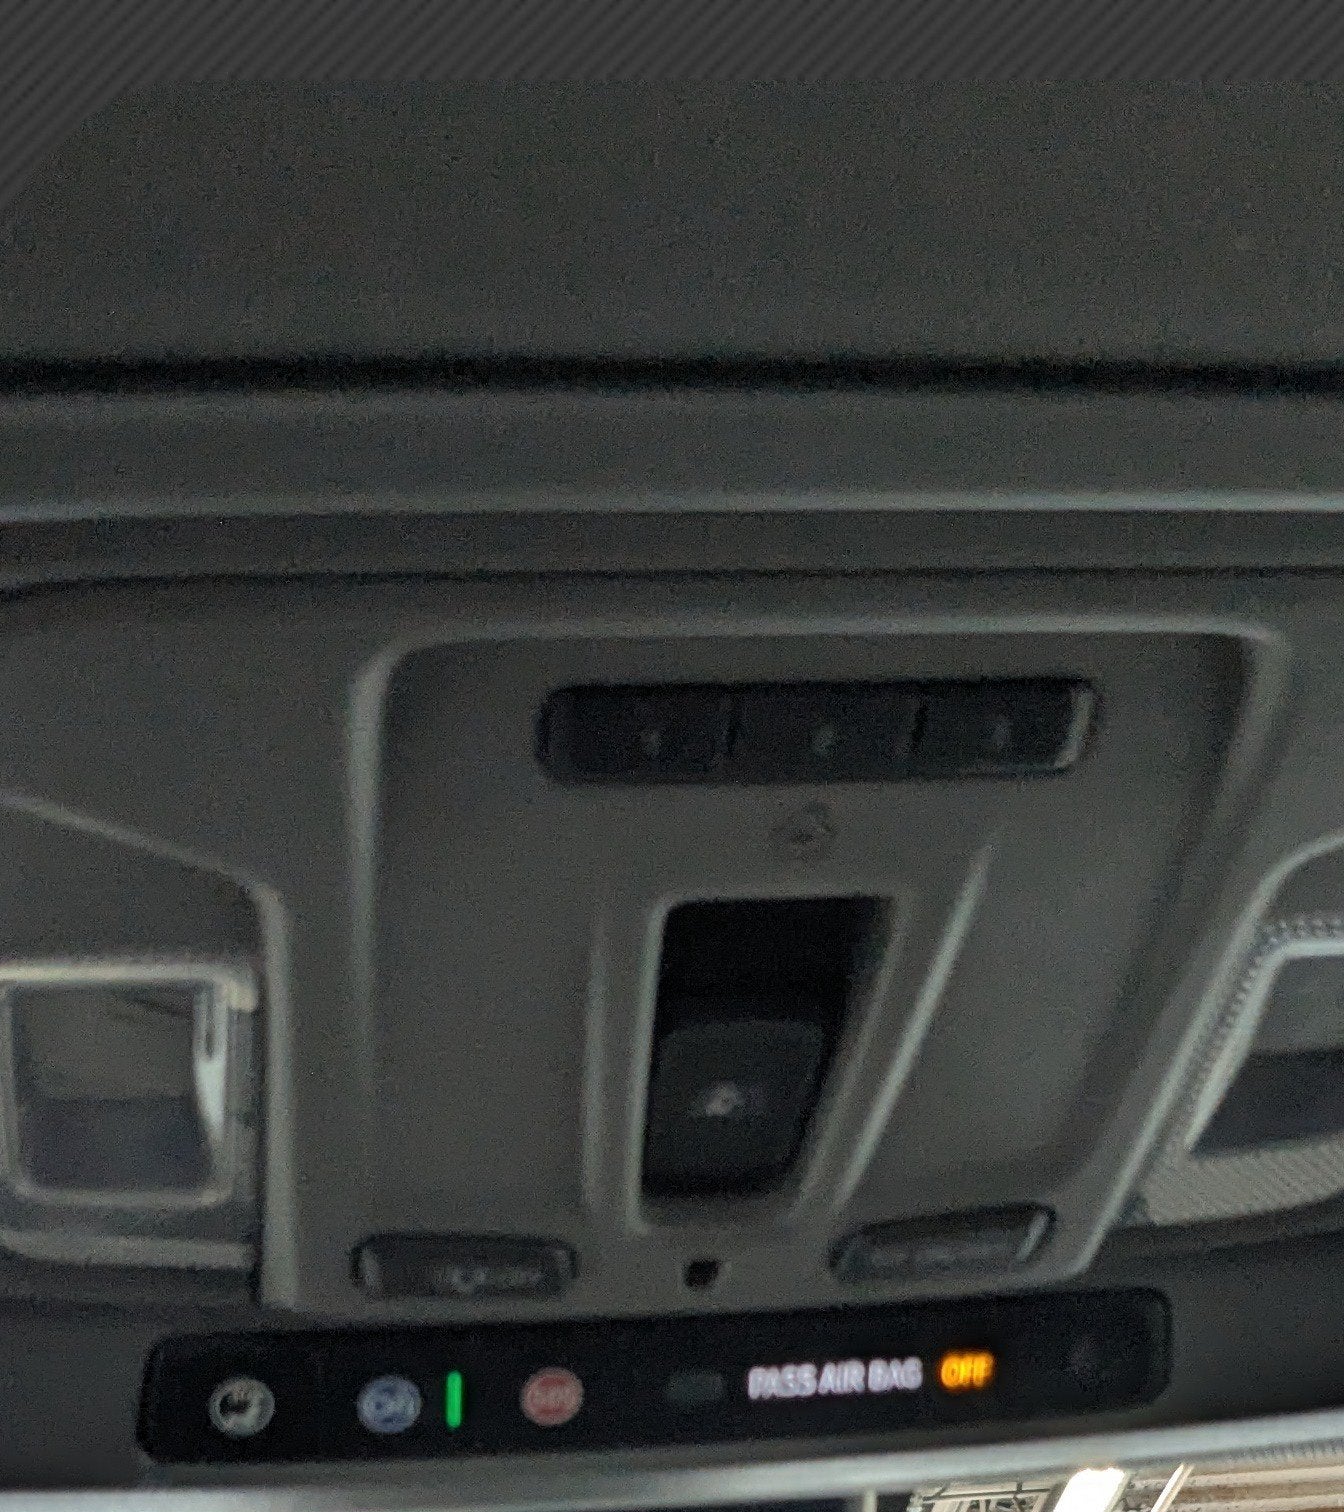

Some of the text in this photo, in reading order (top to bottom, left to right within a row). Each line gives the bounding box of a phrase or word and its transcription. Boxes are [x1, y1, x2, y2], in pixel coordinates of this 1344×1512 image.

[748, 1364, 817, 1399] PASS
[818, 1360, 865, 1394] AIR
[868, 1357, 923, 1391] BAG
[941, 1352, 994, 1388] OFF
